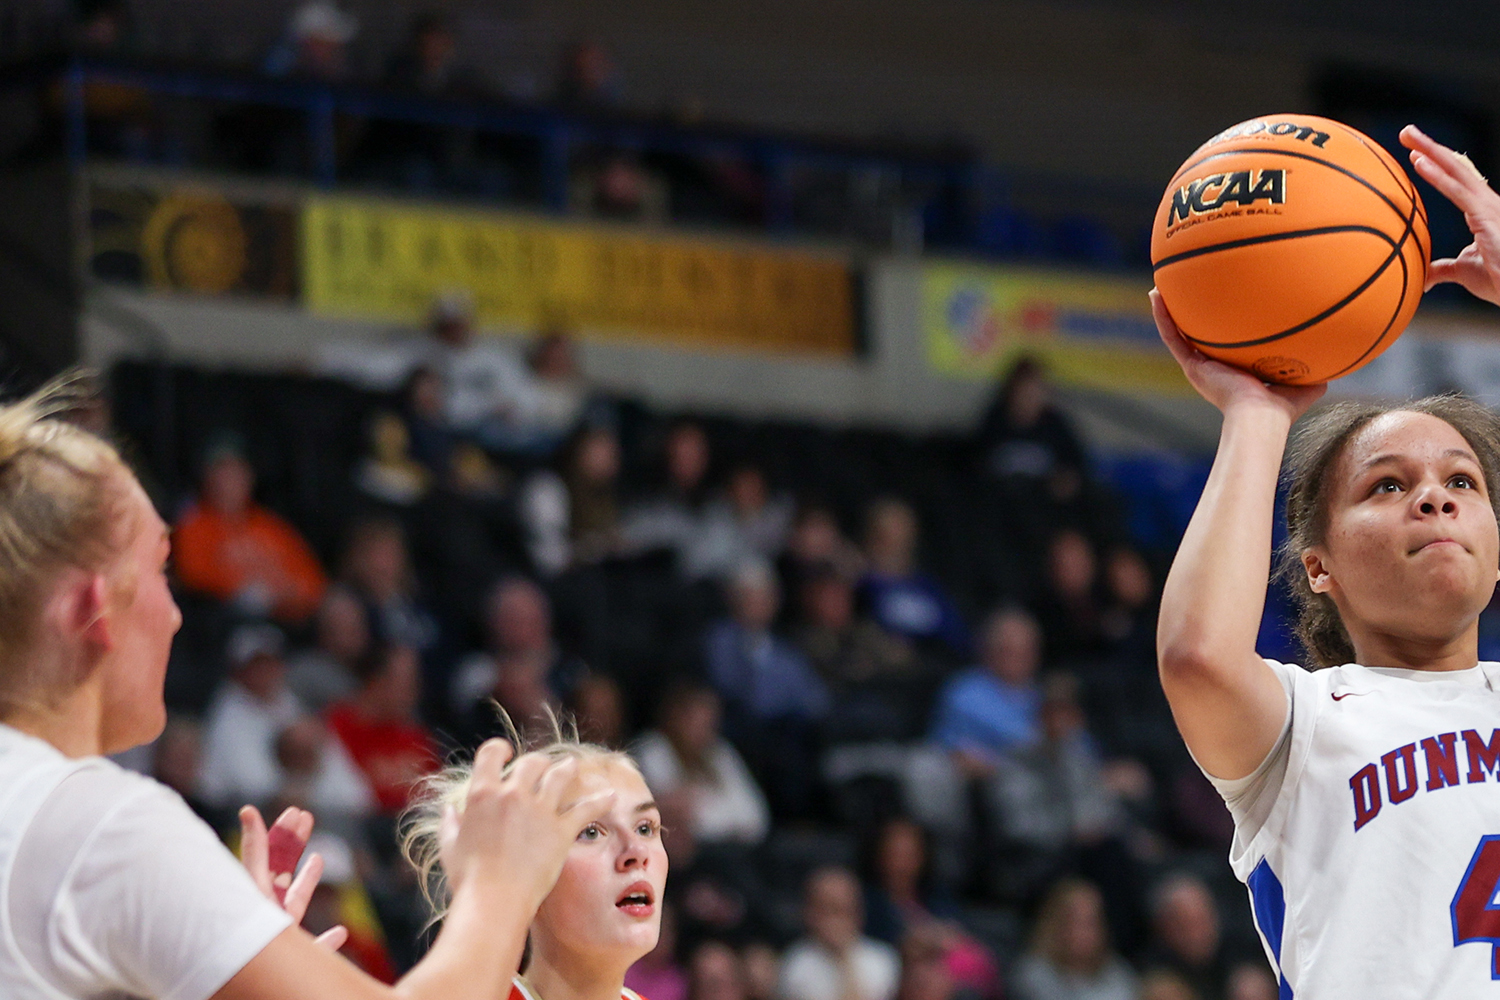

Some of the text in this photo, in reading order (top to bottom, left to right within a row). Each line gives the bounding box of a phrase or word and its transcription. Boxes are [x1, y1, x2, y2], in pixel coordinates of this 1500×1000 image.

[1167, 169, 1287, 229] NCAA
[1207, 209, 1243, 222] GAME
[1246, 207, 1283, 216] BALL
